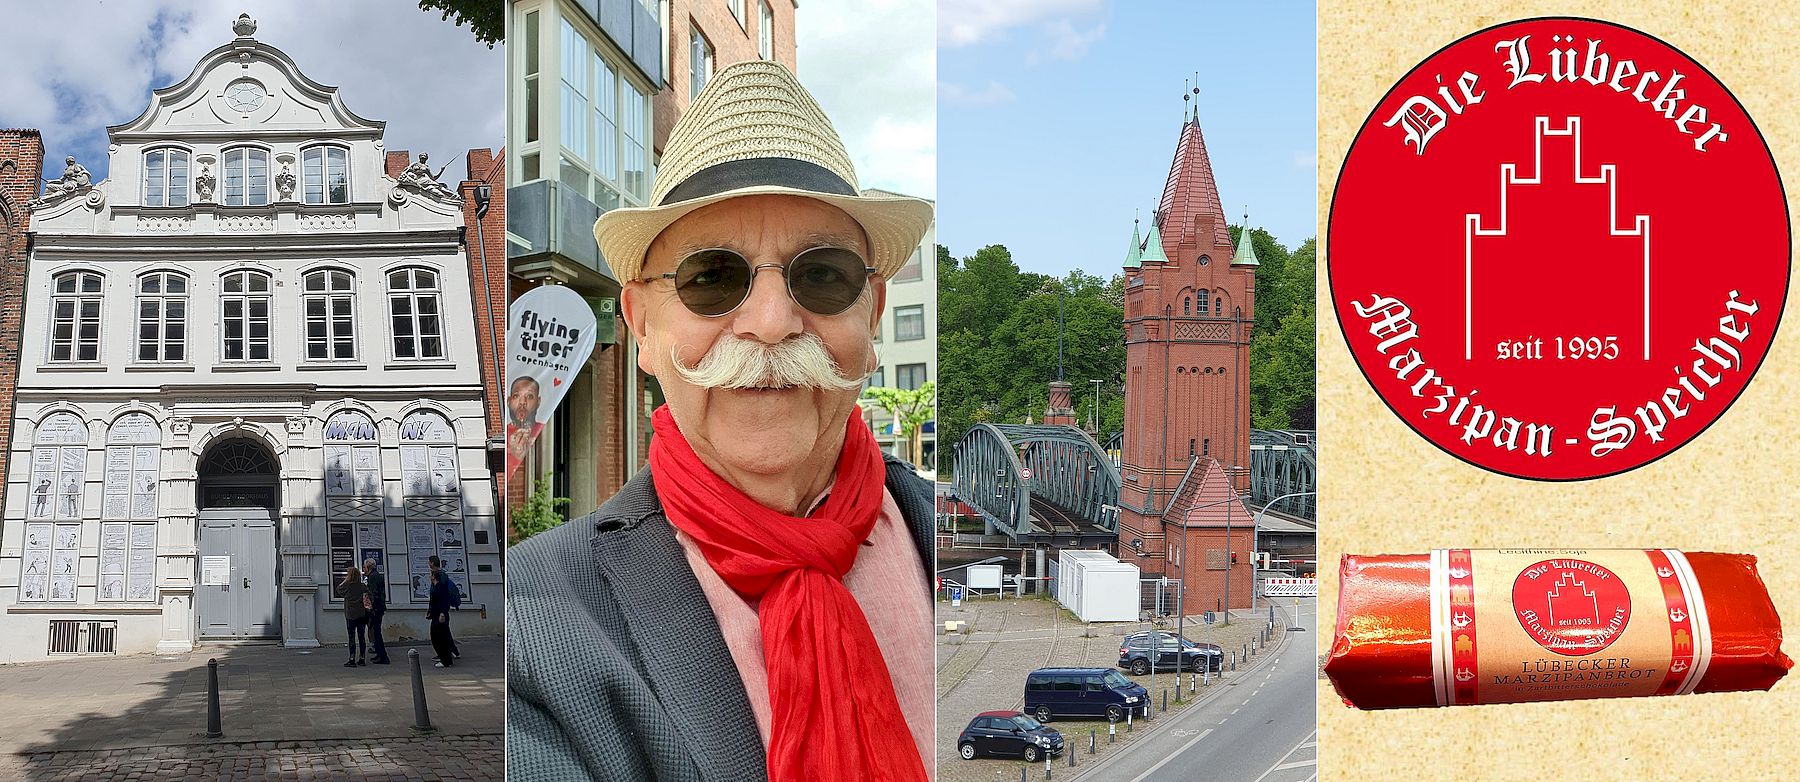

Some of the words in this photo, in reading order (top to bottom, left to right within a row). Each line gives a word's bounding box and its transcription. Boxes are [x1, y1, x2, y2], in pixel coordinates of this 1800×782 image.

[1383, 72, 1487, 156] Die
[1495, 34, 1729, 152] Lübecker
[520, 310, 580, 344] flying
[521, 332, 574, 358] tiger
[1496, 335, 1543, 360] seit
[1554, 335, 1620, 361] 1995
[516, 354, 570, 372] copenhagen
[1524, 565, 1548, 580] Die
[1558, 618, 1572, 626] seit
[1521, 658, 1631, 673] LÜBECKER
[1494, 669, 1656, 685] MARZIPANBROT
